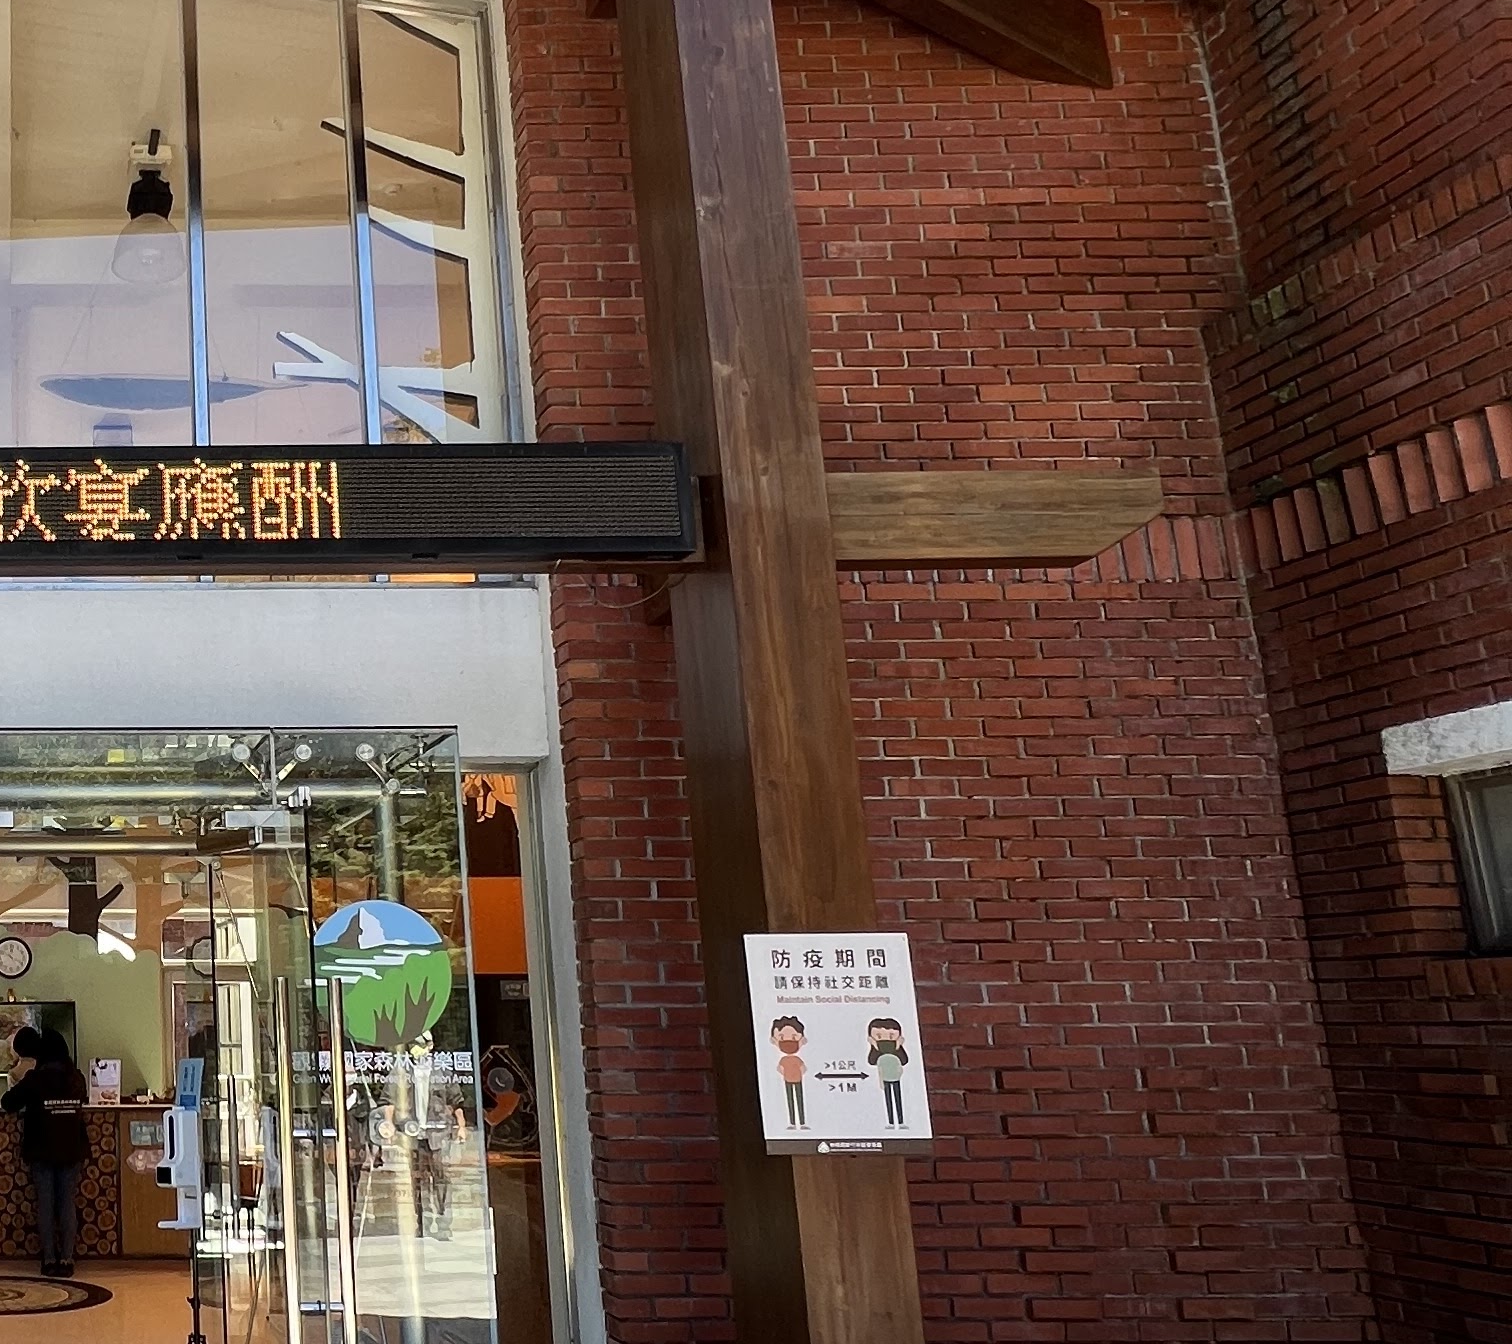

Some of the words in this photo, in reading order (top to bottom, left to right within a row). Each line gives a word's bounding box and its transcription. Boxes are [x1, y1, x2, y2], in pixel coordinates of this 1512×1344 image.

[771, 948, 887, 969] 防疫期間
[774, 975, 889, 990] 請保持社交距離
[776, 995, 814, 1004] Maintain
[815, 995, 842, 1004] Social
[844, 995, 891, 1005] Distancing
[453, 1073, 474, 1084] Area
